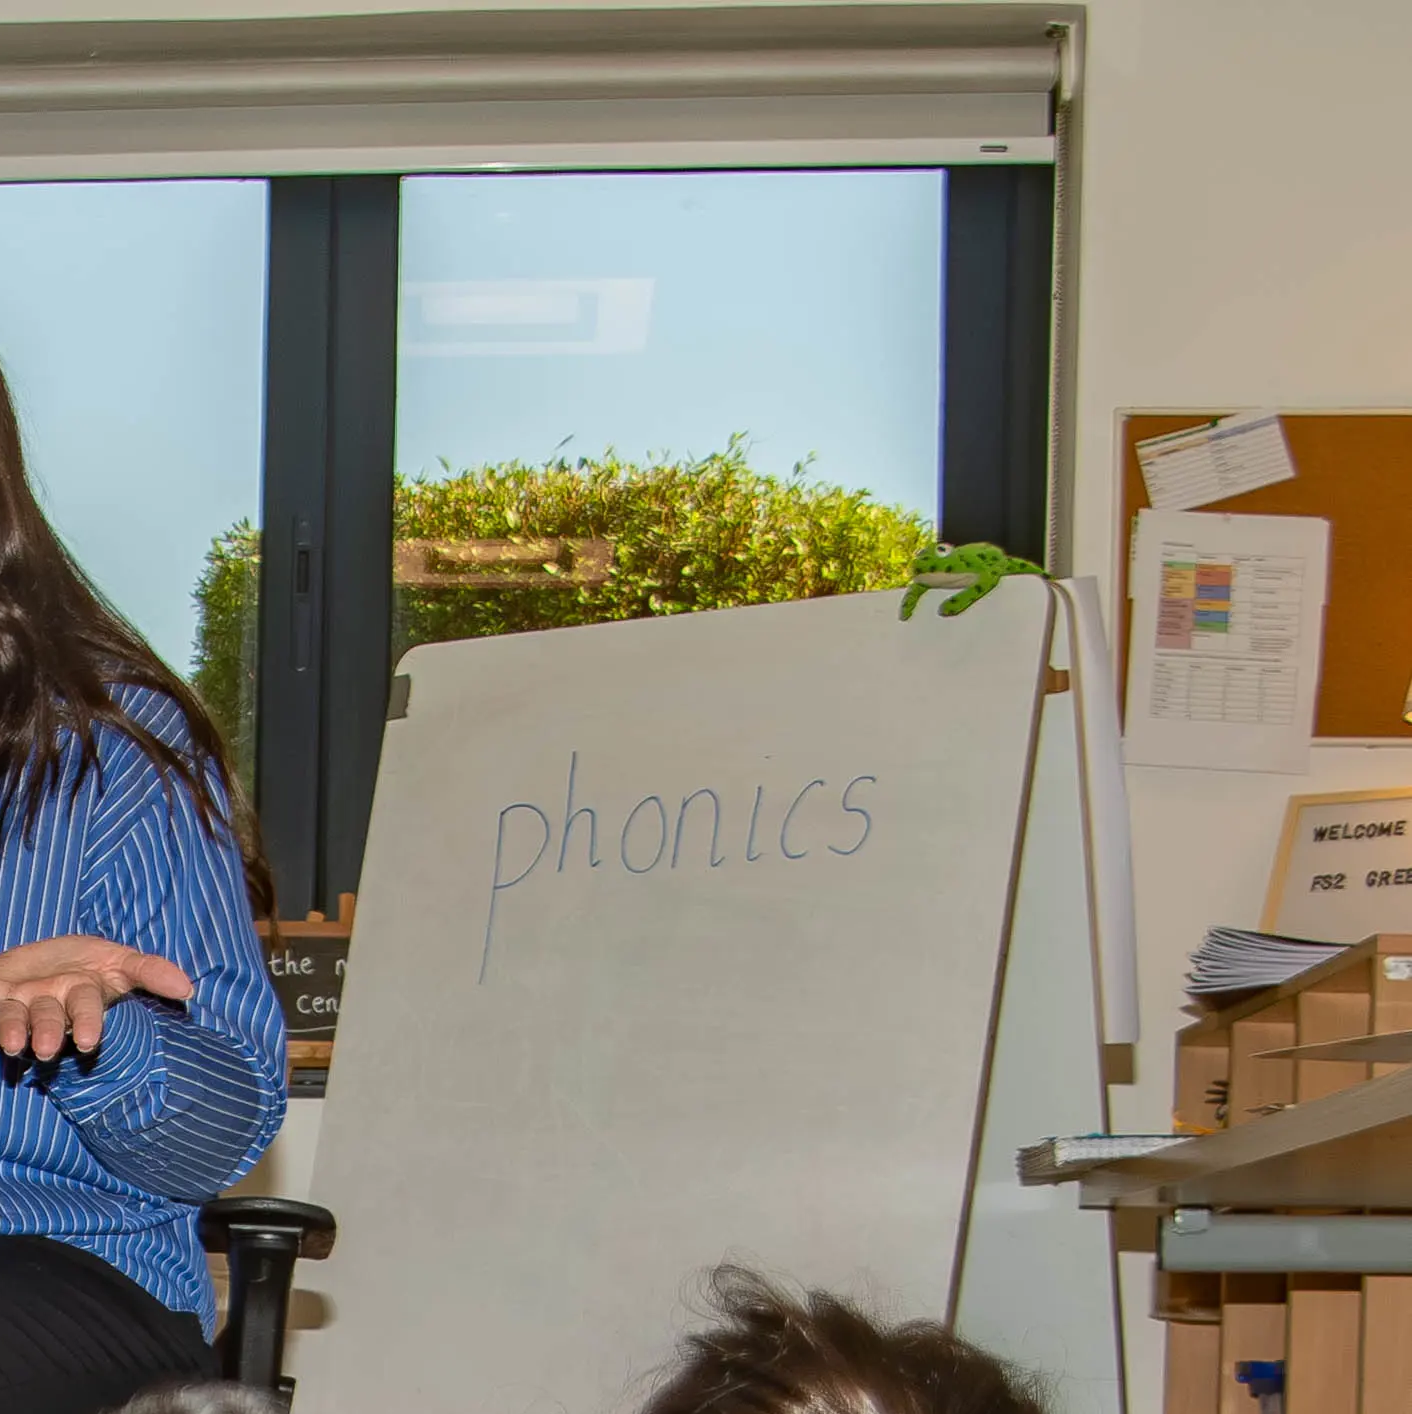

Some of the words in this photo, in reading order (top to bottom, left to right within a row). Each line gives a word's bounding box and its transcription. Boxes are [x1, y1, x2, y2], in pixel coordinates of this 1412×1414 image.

[1313, 819, 1407, 842] WELCOME
[478, 750, 877, 985] phonics
[1310, 872, 1346, 893] FS2
[268, 949, 315, 976] the
